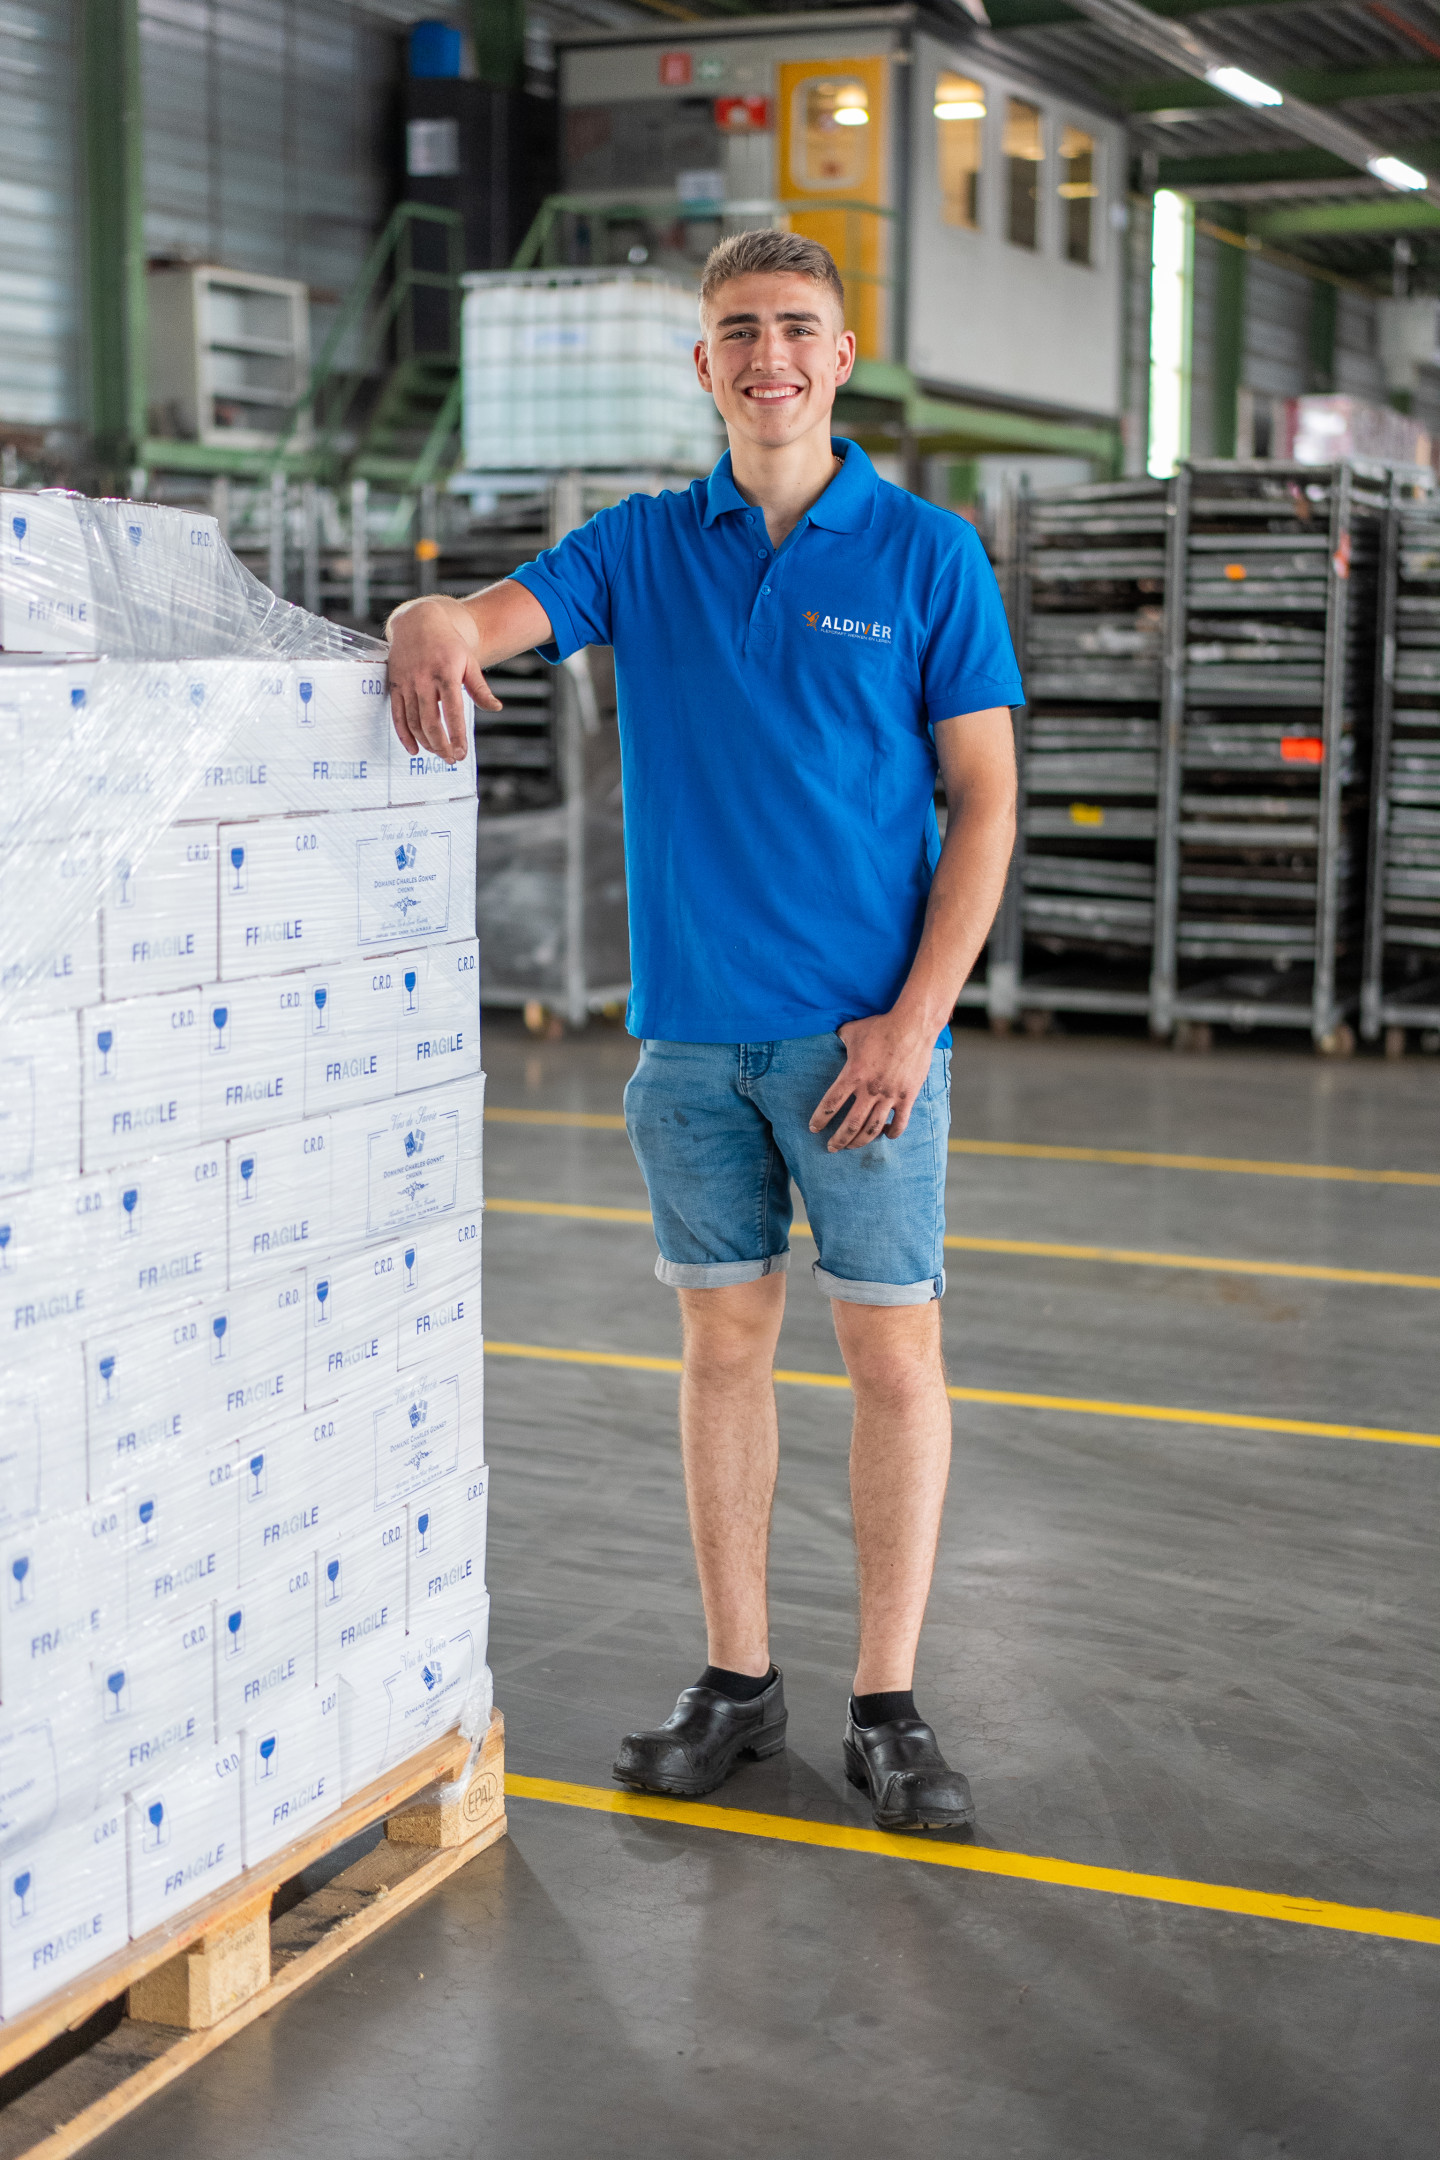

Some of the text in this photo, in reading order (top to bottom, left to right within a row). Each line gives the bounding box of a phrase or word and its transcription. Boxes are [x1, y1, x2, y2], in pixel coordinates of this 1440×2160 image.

[821, 615, 892, 640] ALDIVÈR
[362, 680, 384, 696] C.R.D.
[204, 765, 267, 787] FRAGILE
[312, 760, 368, 780] FRAGILE
[296, 835, 319, 852] C.R.D.
[246, 919, 303, 947] FRAGILE
[132, 933, 195, 963] FRAGILE
[458, 956, 476, 972] C.R.D.
[372, 974, 394, 992] C.R.D.
[280, 992, 302, 1010] C.R.D.
[171, 1008, 196, 1030] C.R.D.
[417, 1033, 464, 1062] FRAGILE
[326, 1055, 378, 1083] FRAGILE
[226, 1077, 284, 1107] FRAGILE
[112, 1100, 178, 1135] FRAGILE
[304, 1135, 326, 1155] C.R.D.
[253, 1220, 309, 1254] FRAGILE
[458, 1224, 478, 1242] C.R.D.
[138, 1251, 203, 1289] FRAGILE
[374, 1257, 394, 1277] C.R.D.
[14, 1288, 86, 1331] FRAGILE
[278, 1288, 300, 1309] C.R.D.
[417, 1301, 465, 1336] FRAGILE
[328, 1338, 379, 1373] FRAGILE
[227, 1374, 284, 1413] FRAGILE
[116, 1414, 182, 1457] FRAGILE
[314, 1422, 336, 1442] C.R.D.
[467, 1482, 485, 1502] C.R.D.
[264, 1506, 319, 1547] FRAGILE
[382, 1526, 403, 1547] C.R.D.
[154, 1552, 216, 1599] FRAGILE
[288, 1571, 310, 1594] C.R.D.
[428, 1558, 472, 1598] FRAGILE
[341, 1606, 388, 1649] FRAGILE
[244, 1657, 296, 1704] FRAGILE
[129, 1716, 196, 1768] FRAGILE
[273, 1776, 326, 1826] FRAGILE
[468, 1779, 494, 1815] EPAL
[164, 1842, 226, 1896] FRAGILE
[32, 1913, 104, 1970] FRAGILE
